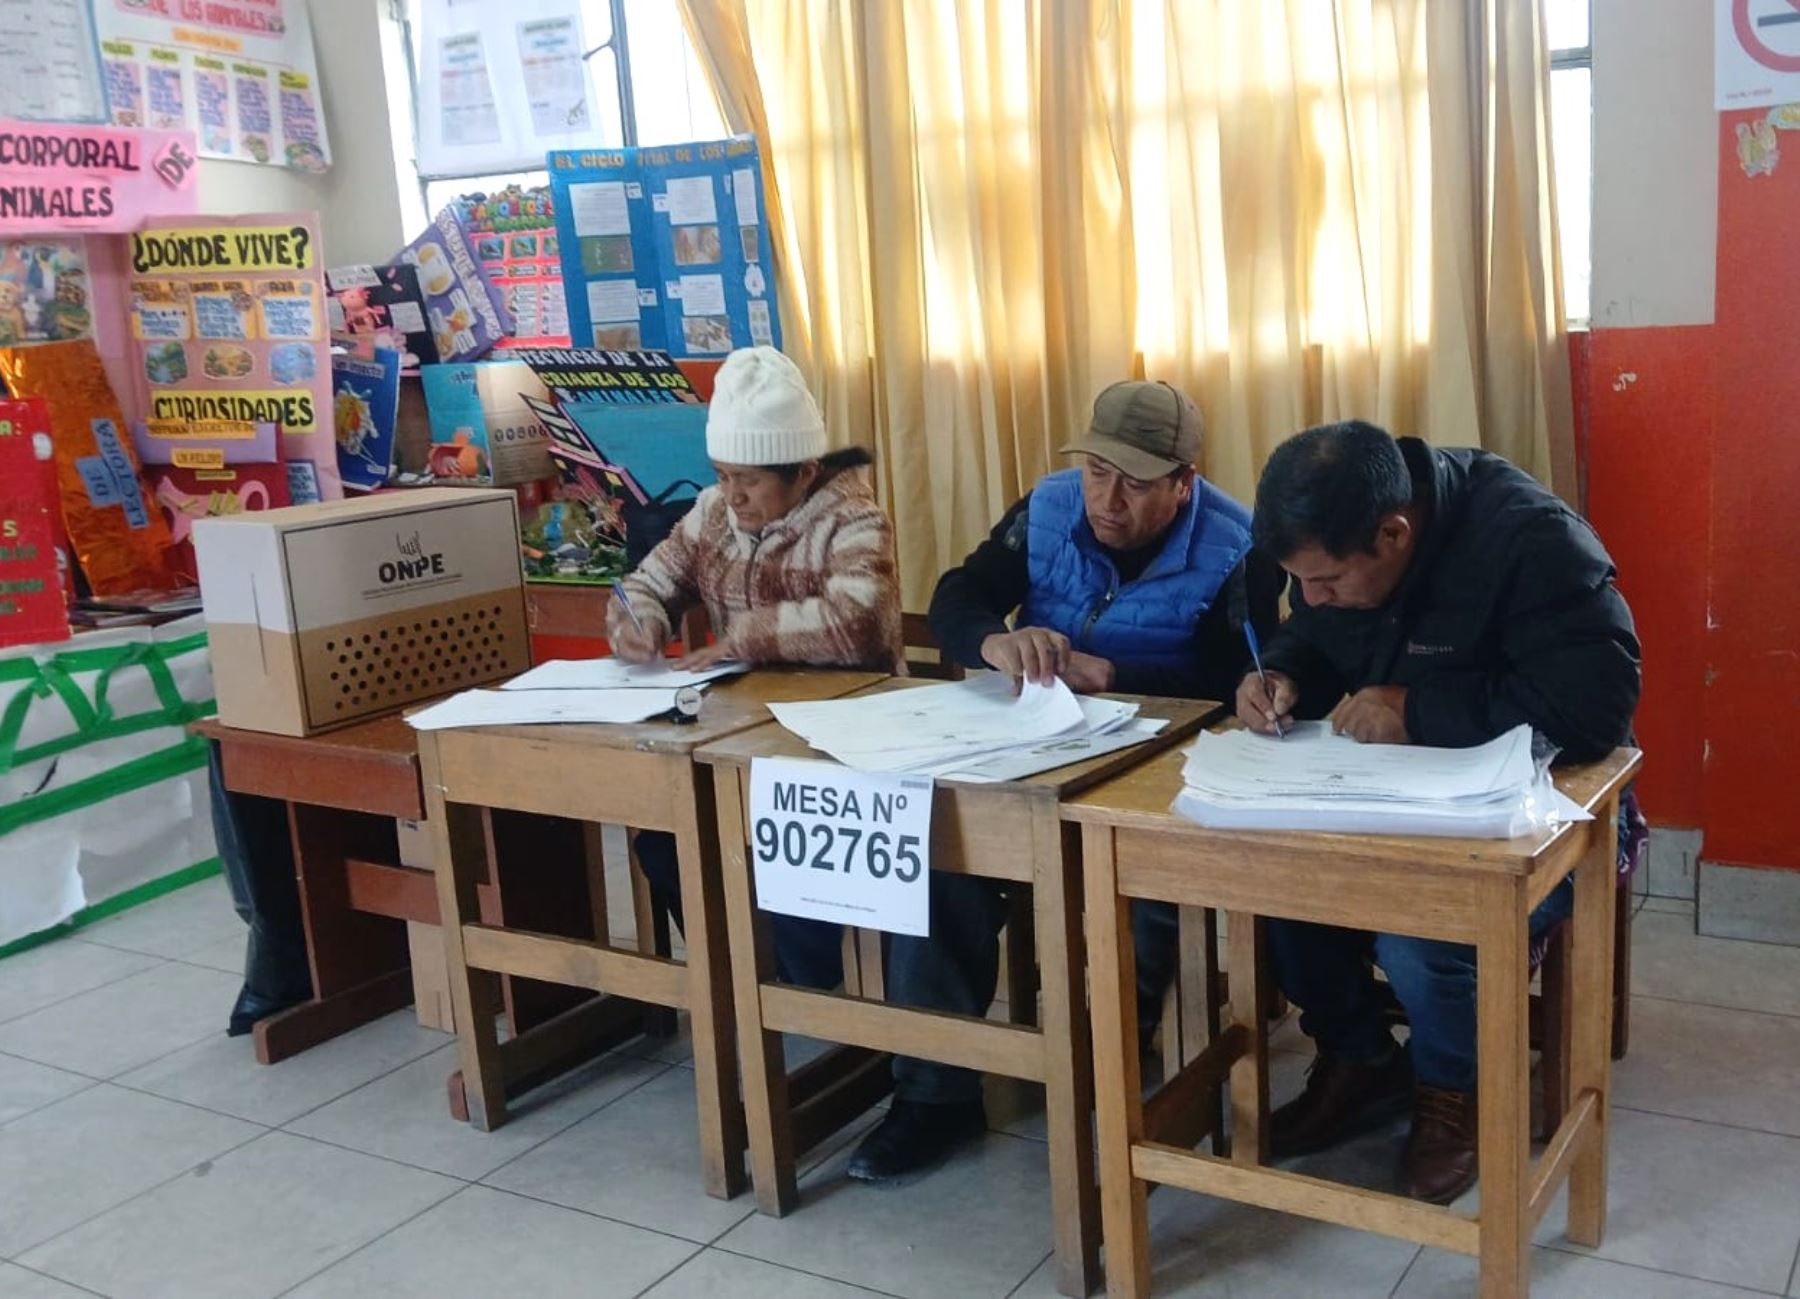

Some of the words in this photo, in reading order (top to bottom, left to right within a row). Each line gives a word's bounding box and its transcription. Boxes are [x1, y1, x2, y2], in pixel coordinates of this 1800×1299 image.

[0, 134, 140, 171] CORPORAL
[159, 142, 194, 184] DE
[0, 187, 113, 218] NIMALES
[235, 227, 309, 269] VIVE?
[607, 351, 637, 366] DE
[638, 352, 670, 366] LA
[540, 372, 622, 387] CRIANZA
[621, 372, 650, 387] DE
[651, 373, 689, 388] LOS
[155, 396, 313, 426] CURIOSIDADES
[379, 553, 445, 583] ONPE
[774, 782, 862, 820] MESA
[756, 817, 921, 882] 902765
